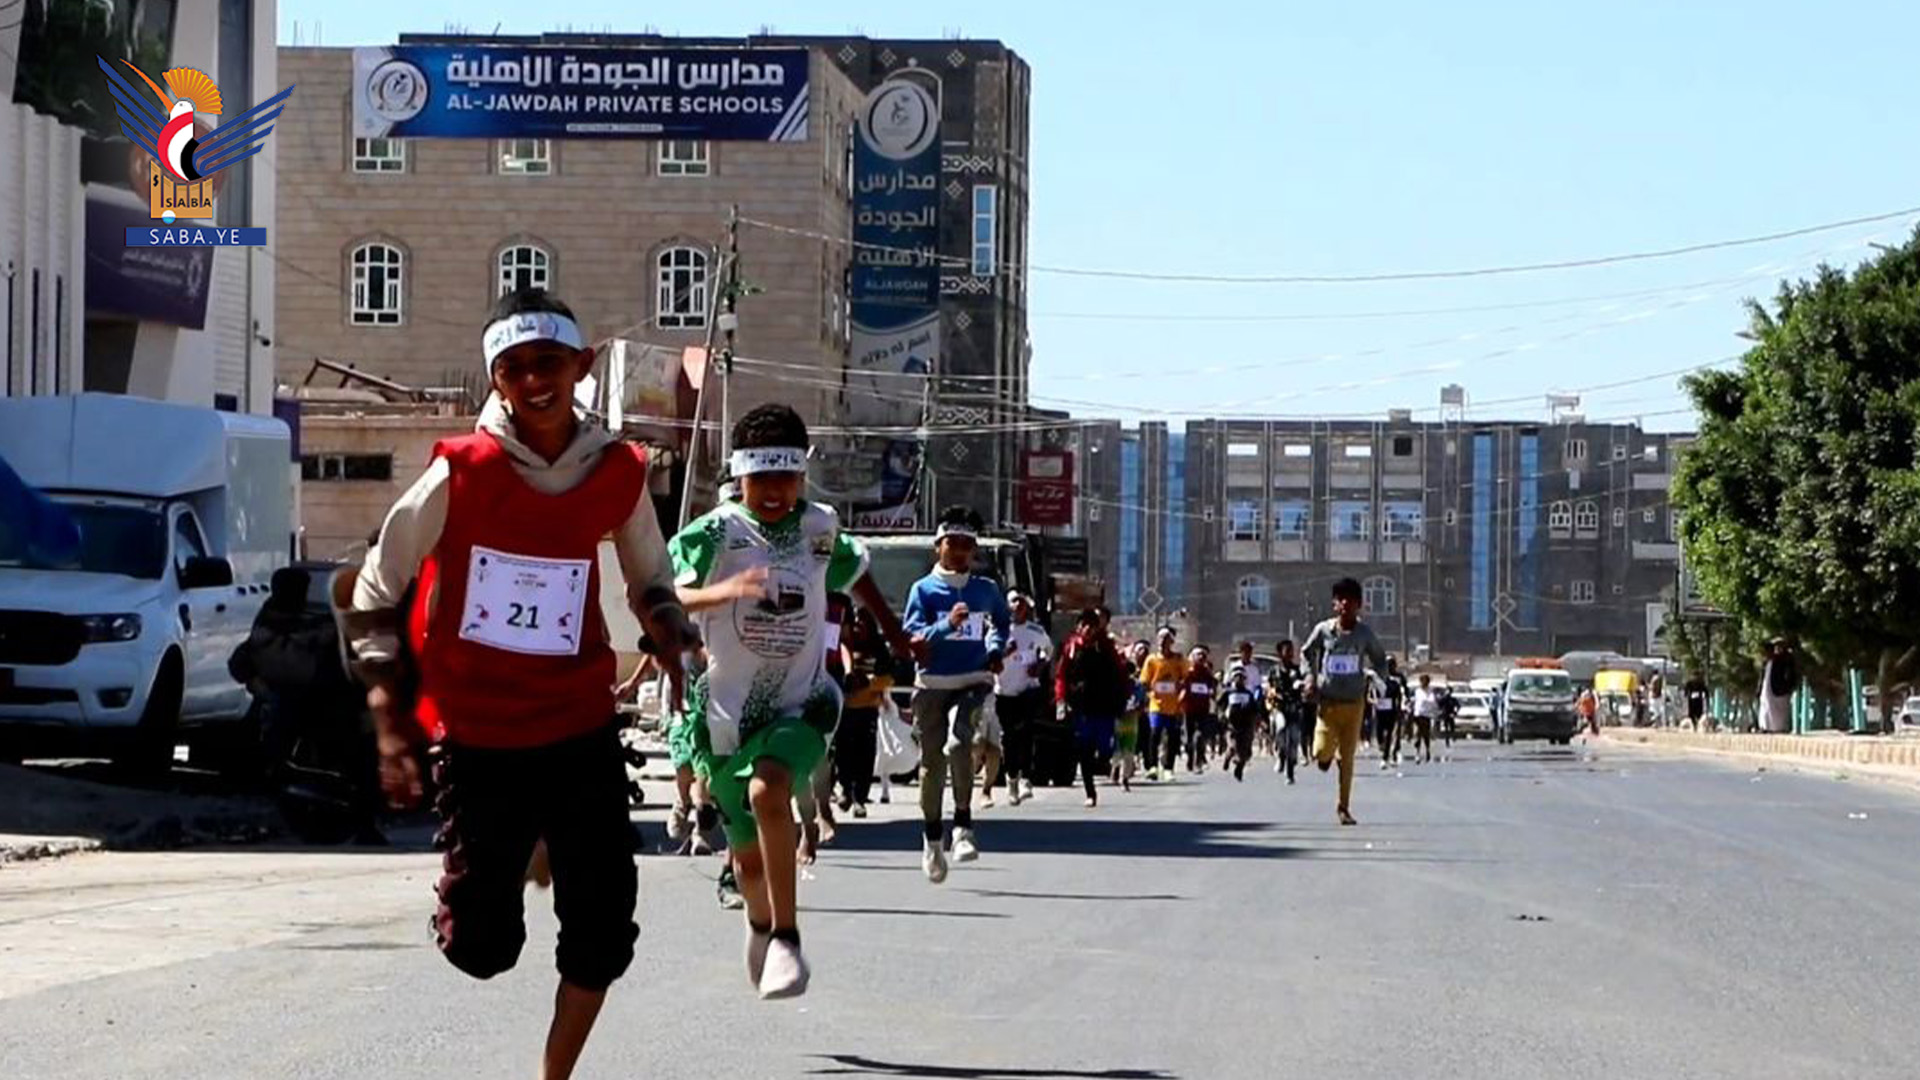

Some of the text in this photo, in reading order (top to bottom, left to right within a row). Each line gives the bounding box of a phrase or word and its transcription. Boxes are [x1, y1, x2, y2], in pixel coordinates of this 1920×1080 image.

[560, 55, 671, 91] الجودة
[678, 58, 785, 90] مدارس
[447, 93, 784, 114] AL-JAWDAH PRIVATE SCHOOLS
[858, 167, 936, 193] مدارس
[858, 205, 936, 233] الجودة
[506, 602, 540, 630] 21
